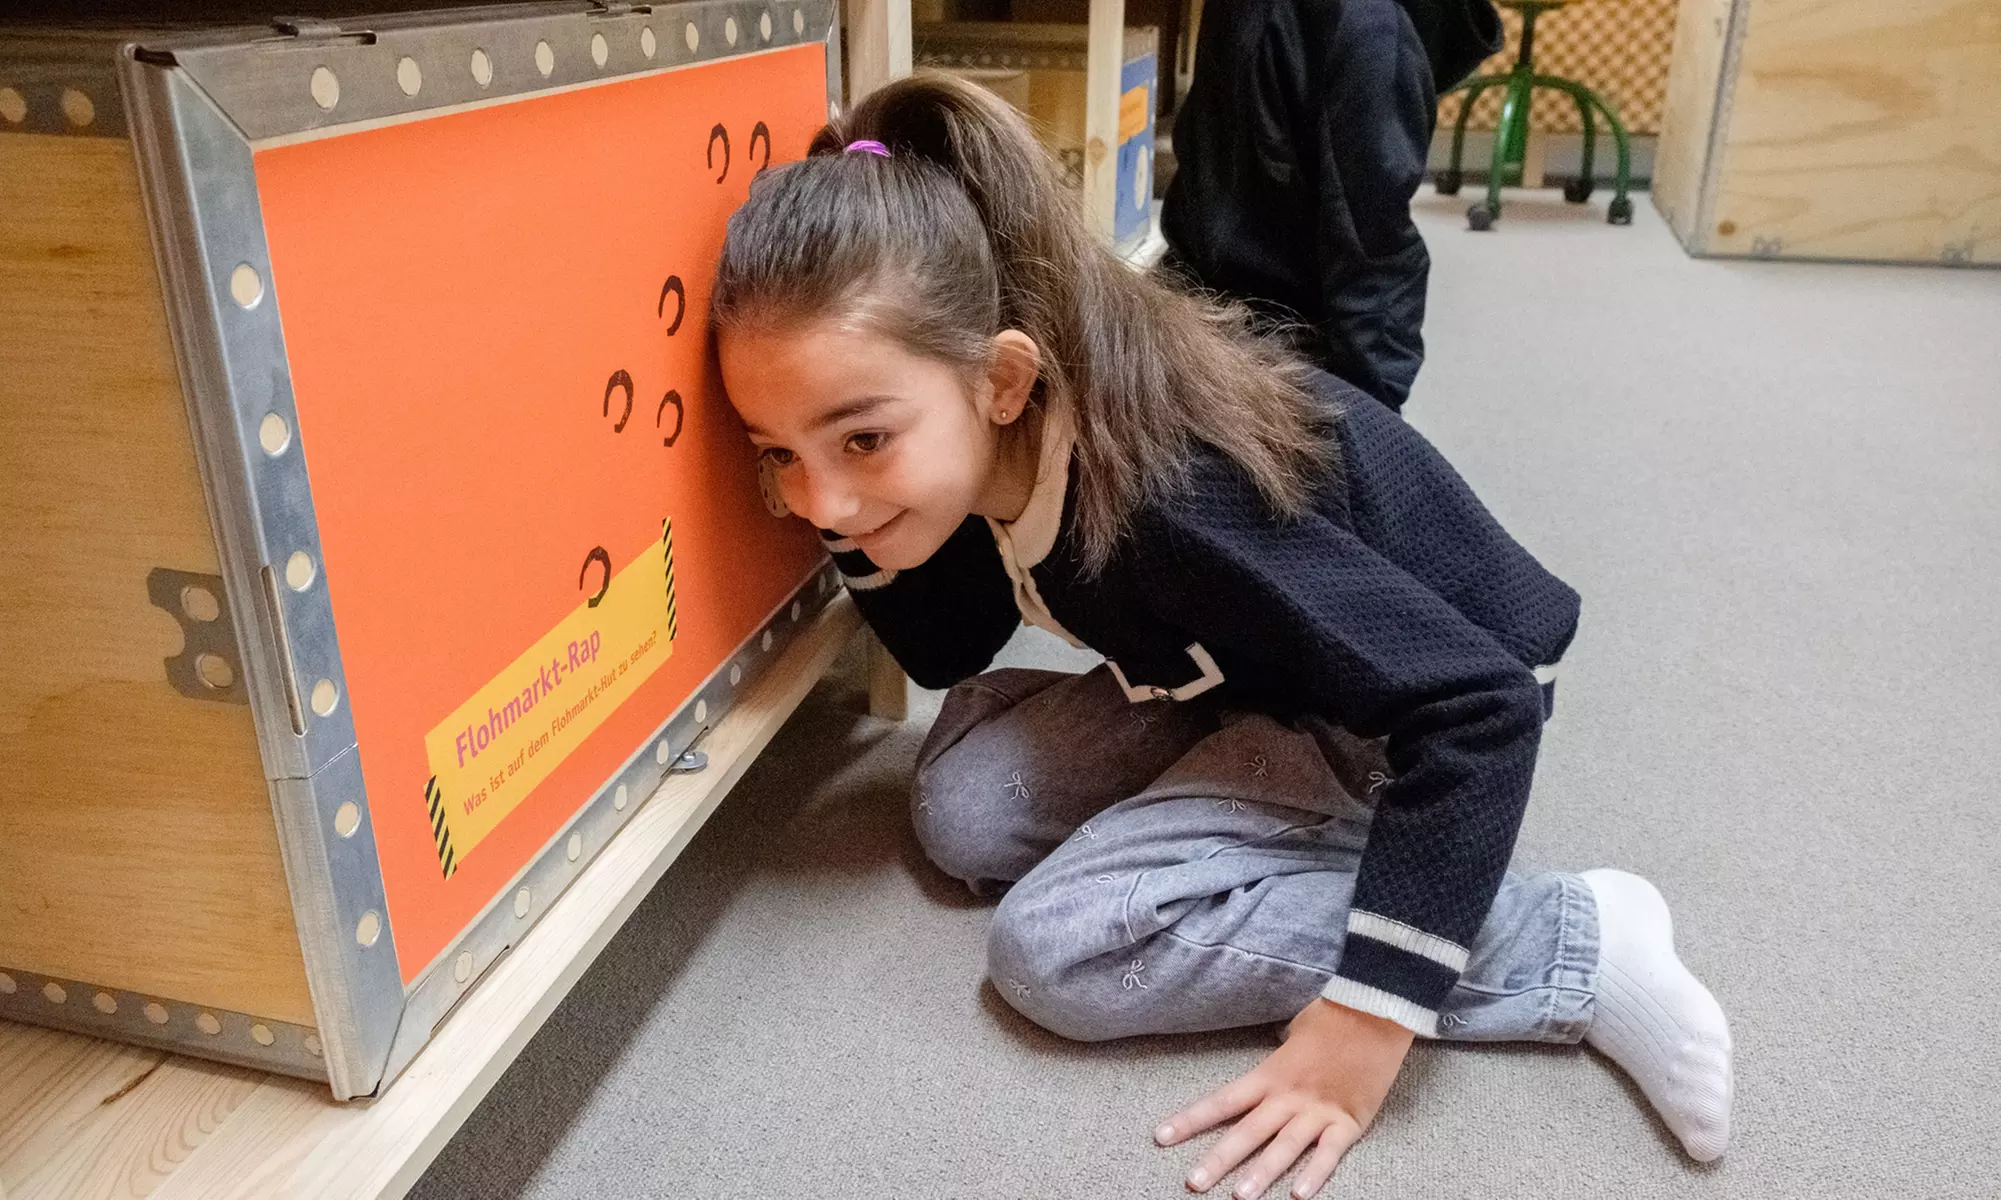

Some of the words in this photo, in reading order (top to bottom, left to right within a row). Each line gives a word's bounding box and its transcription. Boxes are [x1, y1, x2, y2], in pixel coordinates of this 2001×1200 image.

[455, 630, 600, 768] Flohmarkt-Rap
[463, 788, 487, 816] Was
[489, 769, 505, 791] ist
[507, 752, 525, 777] auf
[528, 729, 549, 756] dem
[551, 668, 617, 737] Flohmarkt-Hut
[618, 658, 629, 676] zu
[629, 630, 657, 666] sehen?
